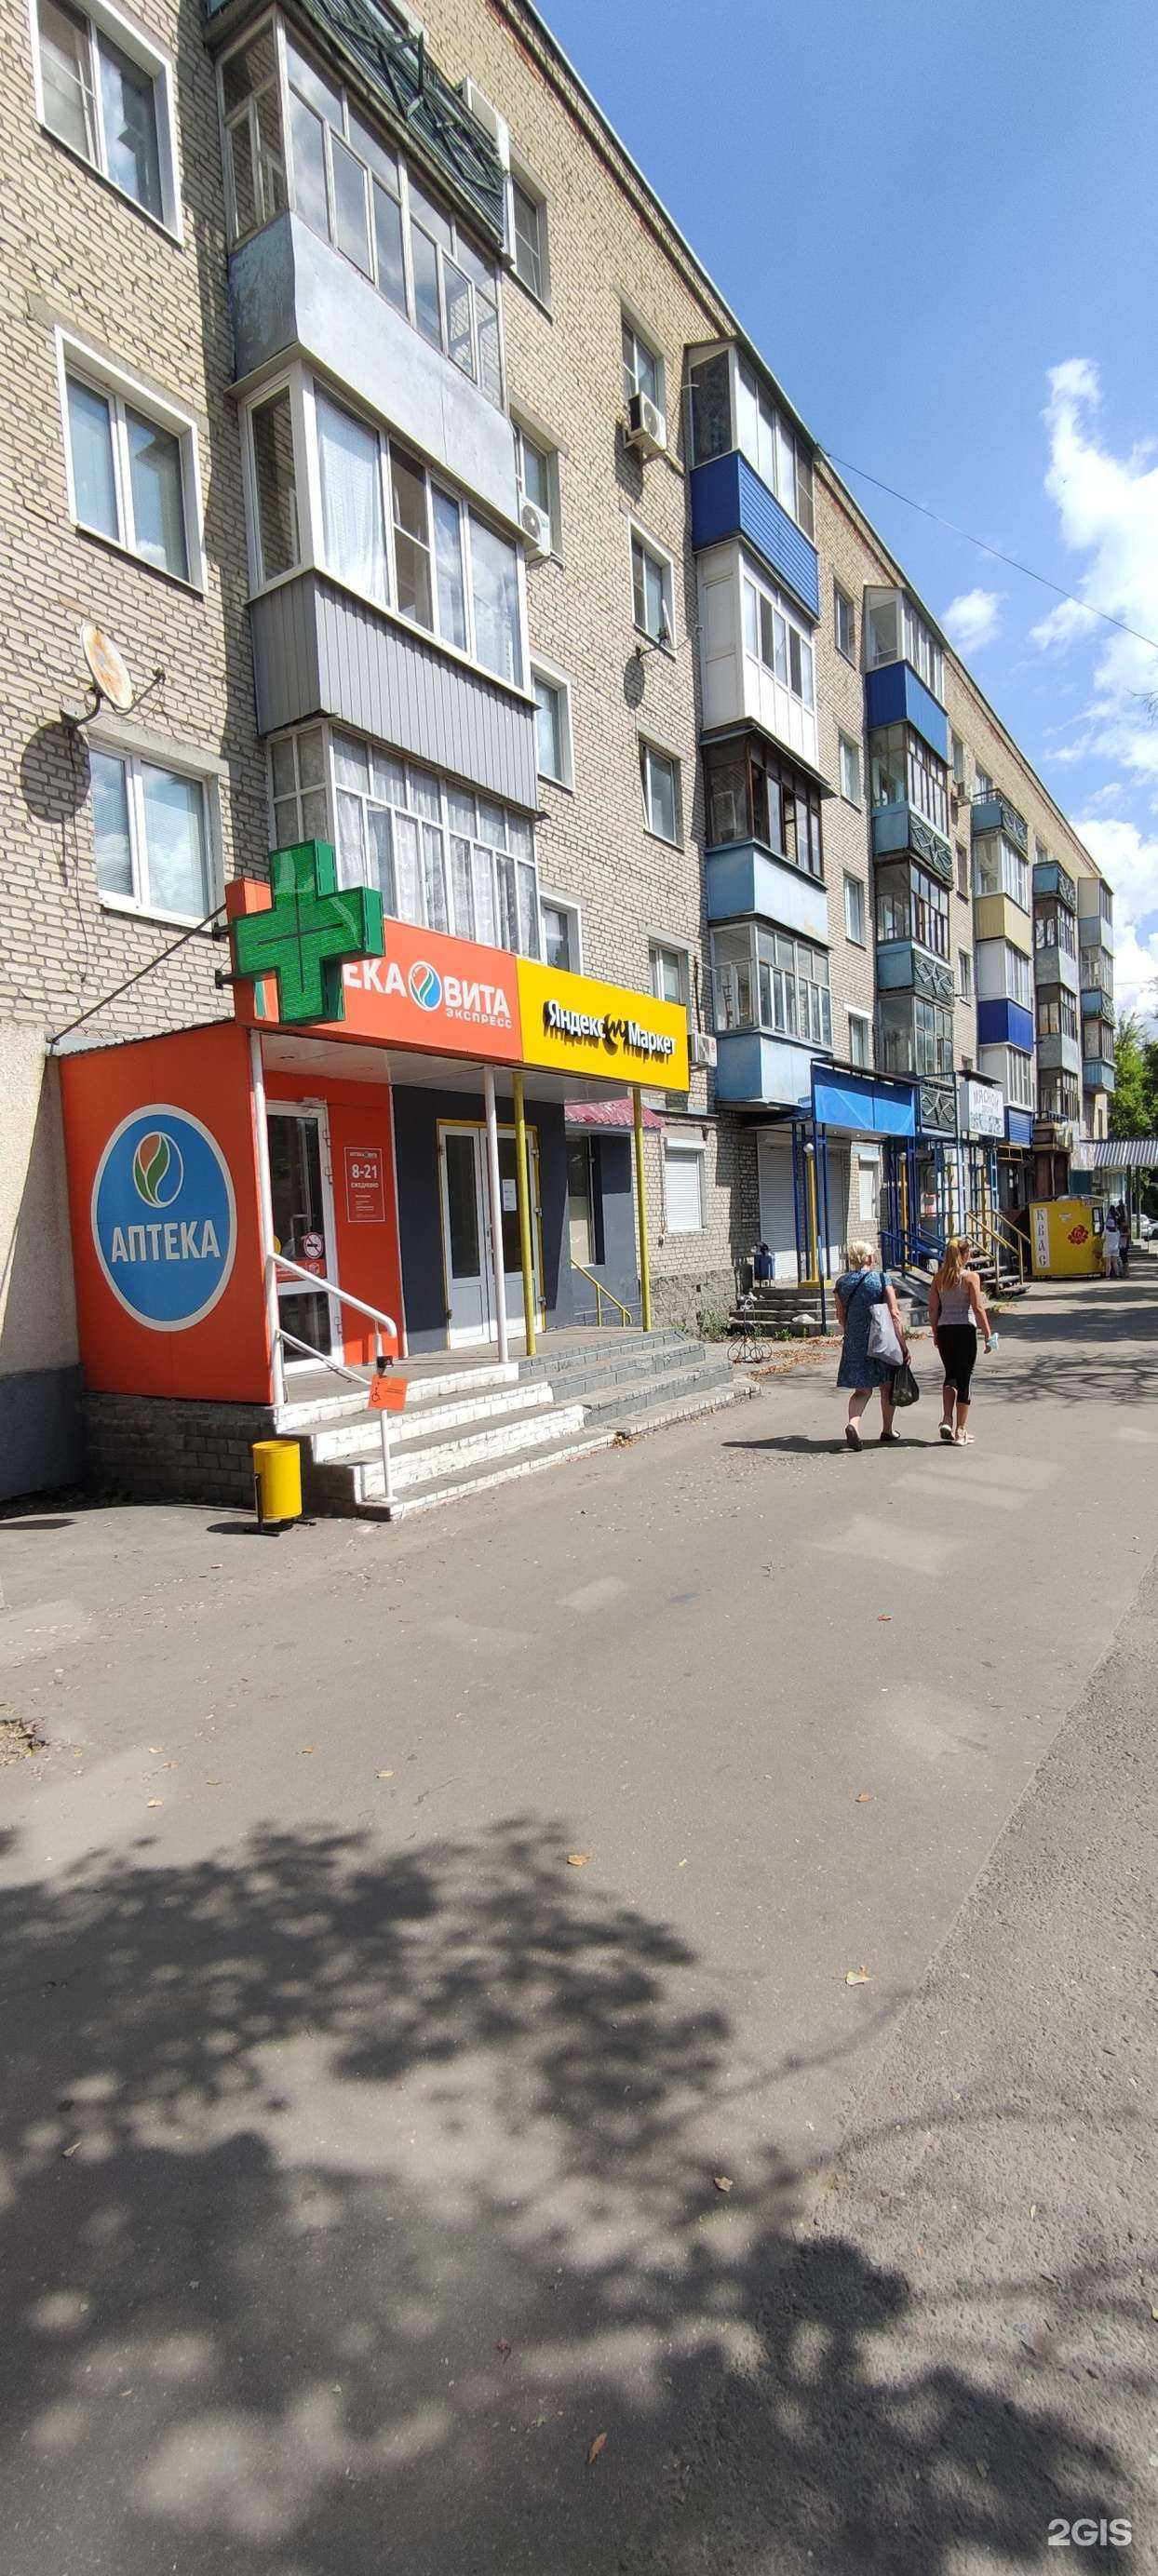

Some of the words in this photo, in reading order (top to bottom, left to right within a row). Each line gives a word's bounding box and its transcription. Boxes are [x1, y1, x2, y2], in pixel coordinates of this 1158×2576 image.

[343, 959, 408, 998] ЕКА
[443, 975, 511, 1019] ВИТА
[445, 1008, 513, 1029] ЭКСПРЕСС
[546, 998, 607, 1039] Яндекс
[626, 1020, 678, 1055] Маркет
[351, 1163, 378, 1179] 8-21
[112, 1219, 222, 1264] АПТЕКА
[1036, 1209, 1047, 1267] КВАС
